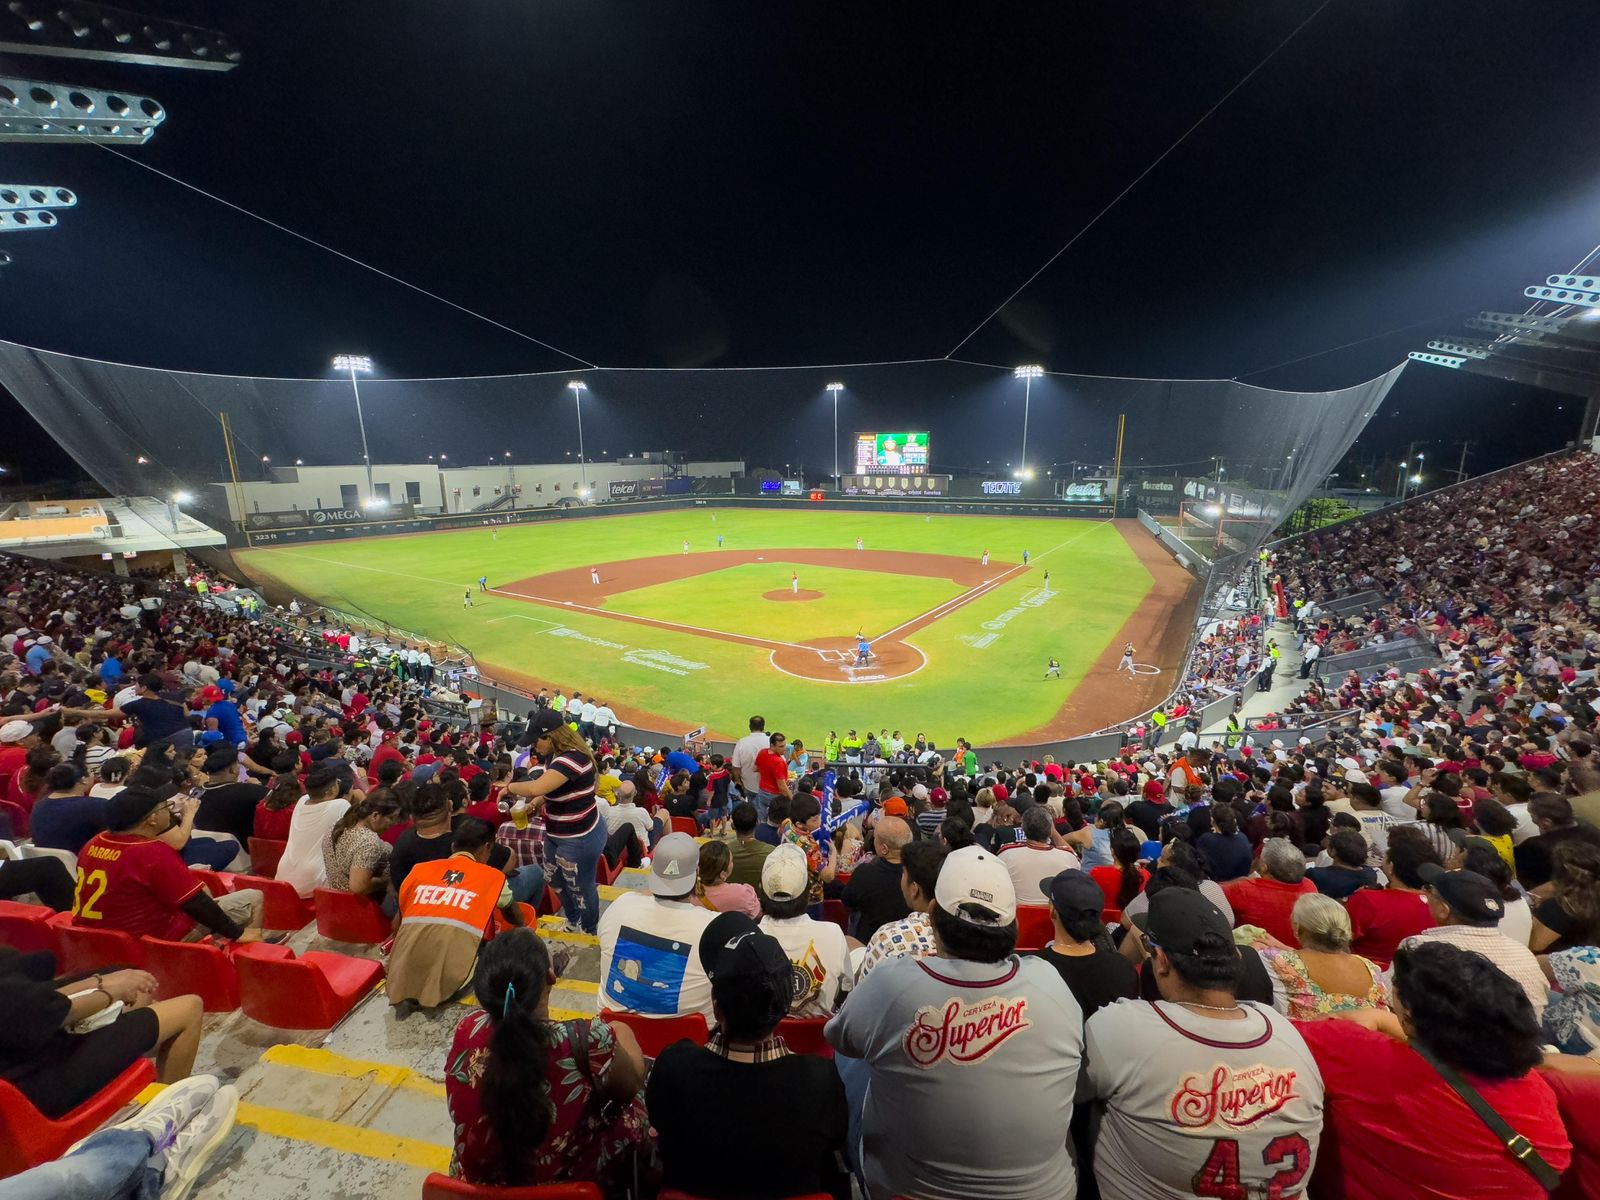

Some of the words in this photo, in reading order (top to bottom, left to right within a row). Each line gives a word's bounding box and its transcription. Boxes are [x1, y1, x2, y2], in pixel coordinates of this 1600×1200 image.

[611, 483, 636, 494] telcel
[981, 481, 1022, 494] TECATE
[413, 884, 479, 911] TECATE
[963, 1000, 997, 1018] CERVEZA
[906, 1001, 1026, 1066] Superior
[1232, 1067, 1266, 1082] CERVEZA
[1171, 1066, 1298, 1128] Superior
[1191, 1131, 1312, 1200] 42
